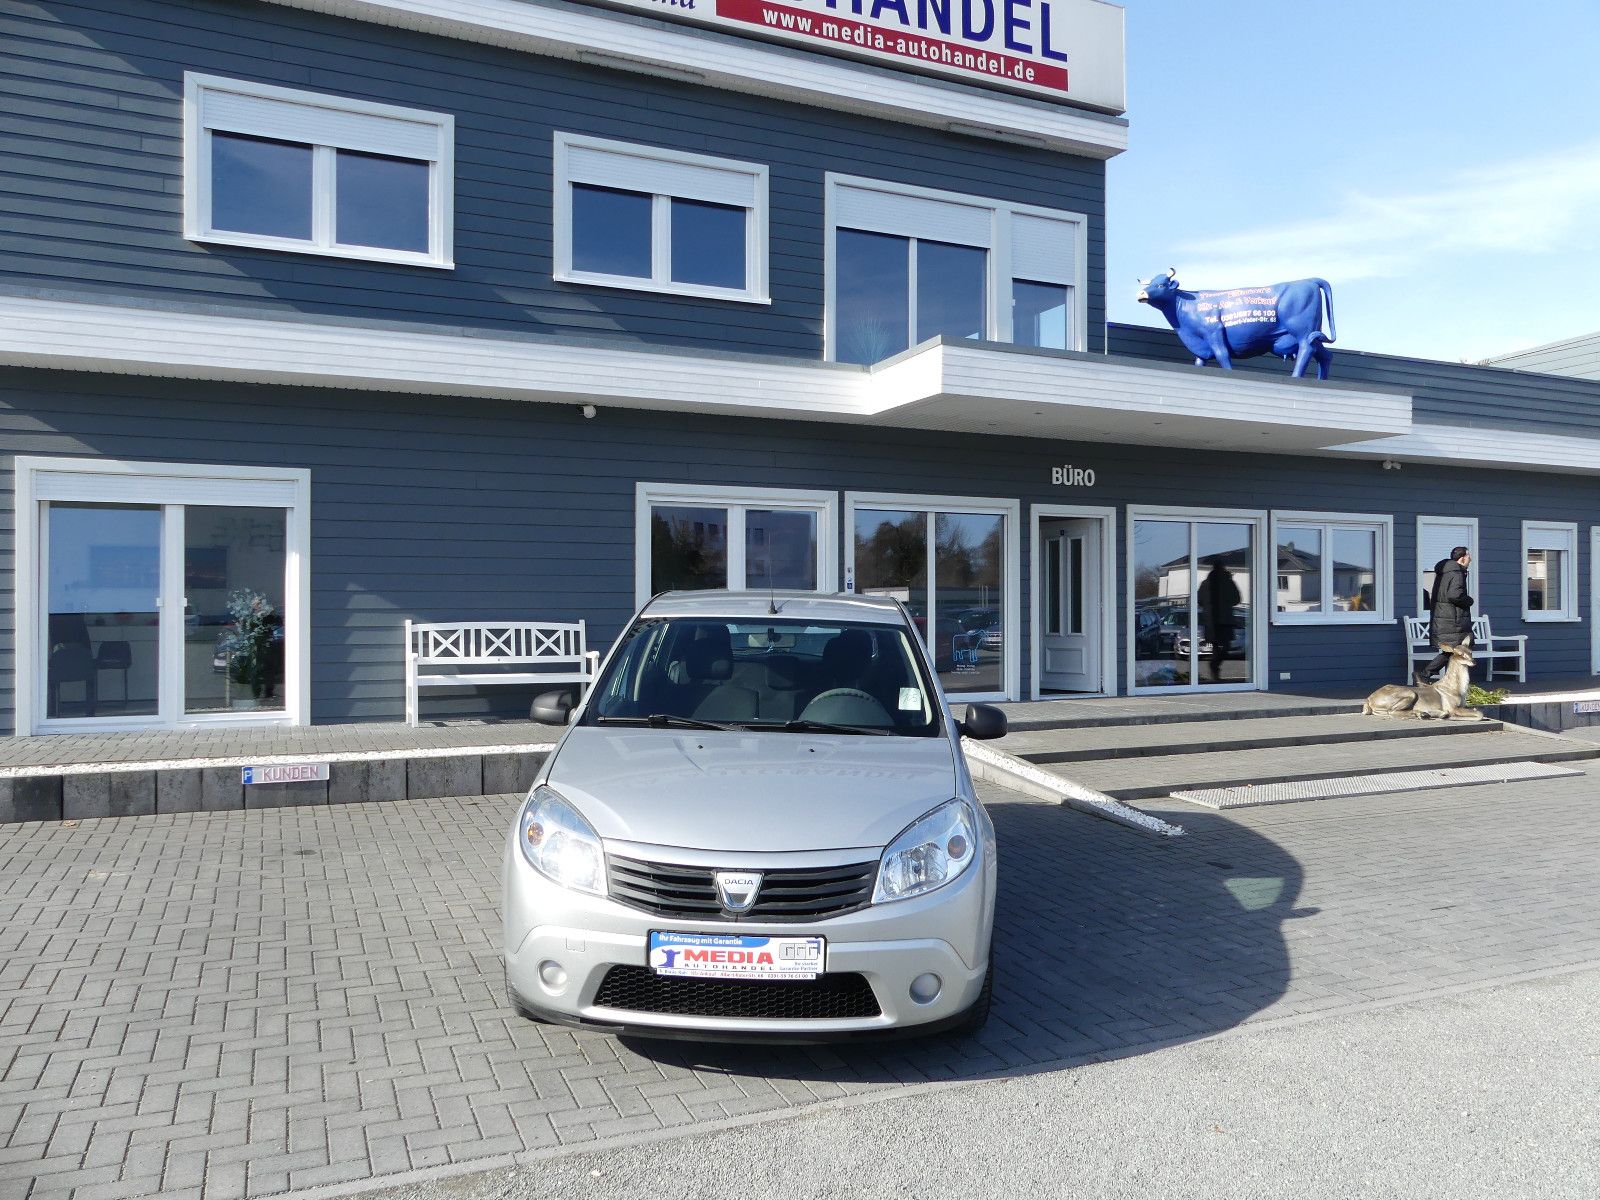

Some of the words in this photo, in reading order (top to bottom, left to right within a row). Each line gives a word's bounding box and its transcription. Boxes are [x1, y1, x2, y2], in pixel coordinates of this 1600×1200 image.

[771, 0, 1067, 62] NDEL
[762, 8, 1036, 81] www.media-autohandel.de
[1263, 309, 1276, 317] 100
[1052, 464, 1096, 486] BÜRO
[244, 770, 252, 780] P
[263, 766, 319, 781] KUNDEN
[724, 878, 754, 886] DACIA
[669, 935, 700, 944] Fahrzeug
[713, 937, 743, 945] Garantie
[684, 949, 774, 965] MEDIA
[684, 963, 774, 971] AUTOHANDEL
